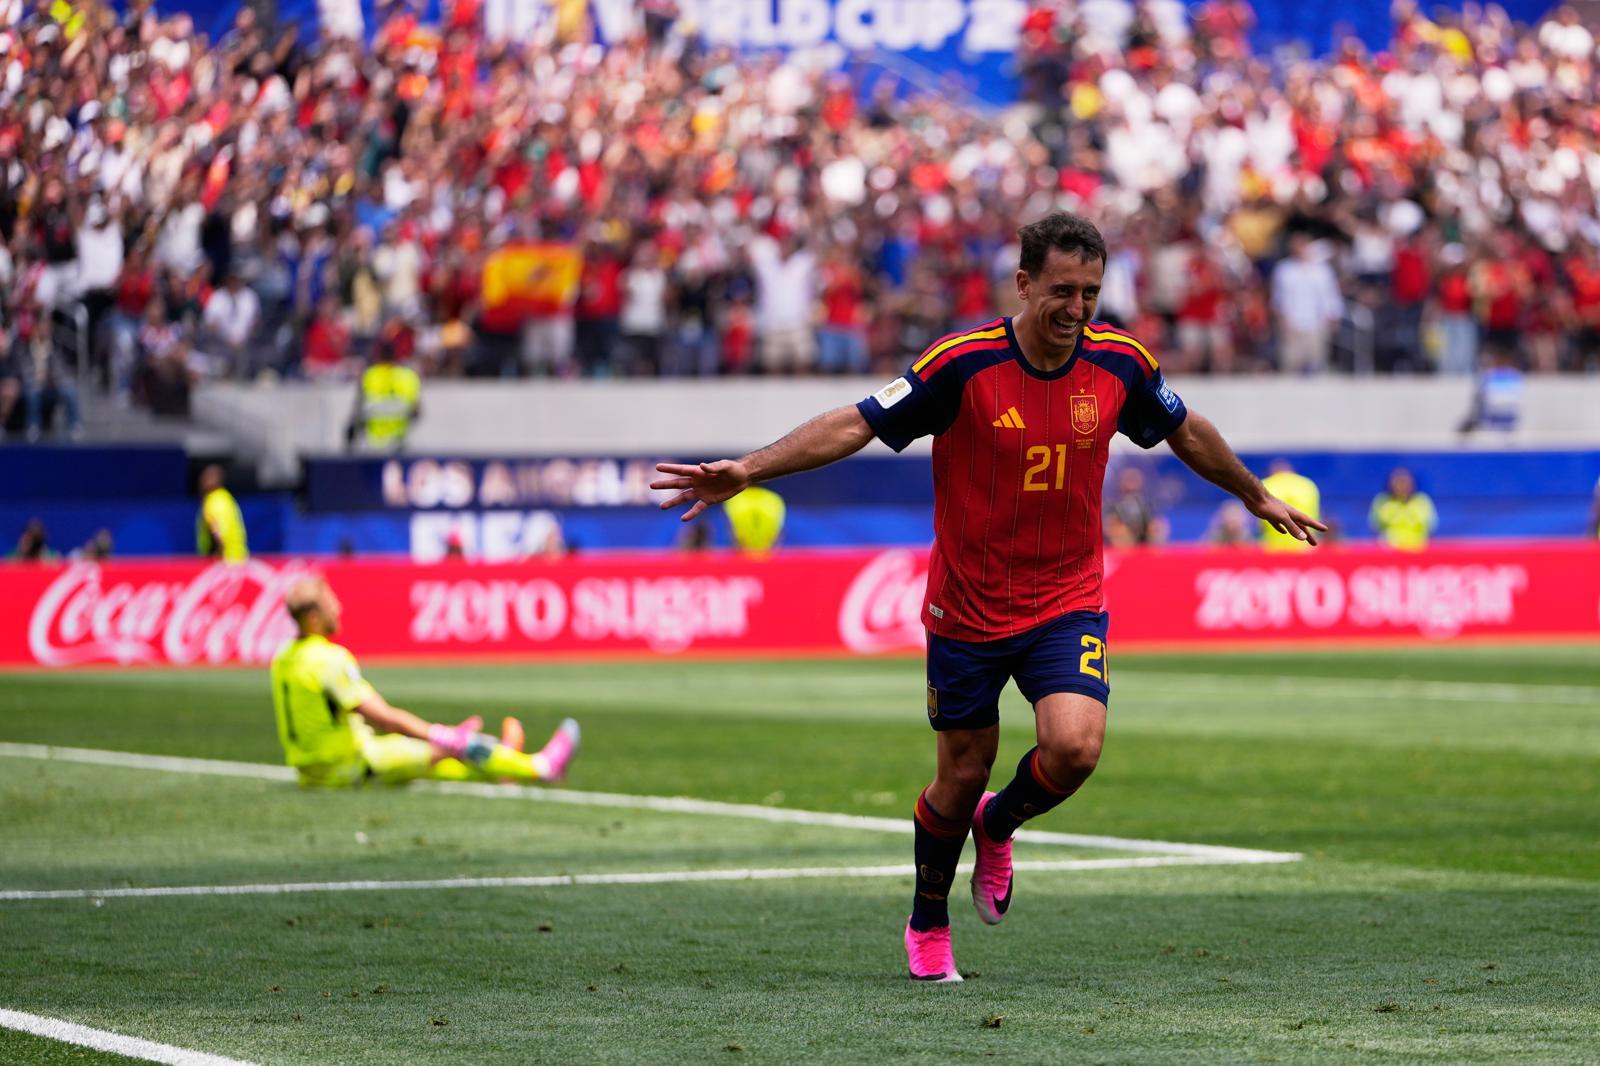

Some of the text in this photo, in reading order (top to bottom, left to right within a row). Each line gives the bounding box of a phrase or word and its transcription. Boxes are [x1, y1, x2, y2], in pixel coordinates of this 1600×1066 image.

[831, 0, 970, 51] CUP
[382, 461, 473, 506] LOS
[1024, 444, 1067, 491] 21
[410, 577, 567, 643] zero
[571, 575, 765, 654] sugar
[1194, 564, 1529, 640] zero sugar
[1080, 634, 1108, 685] 21
